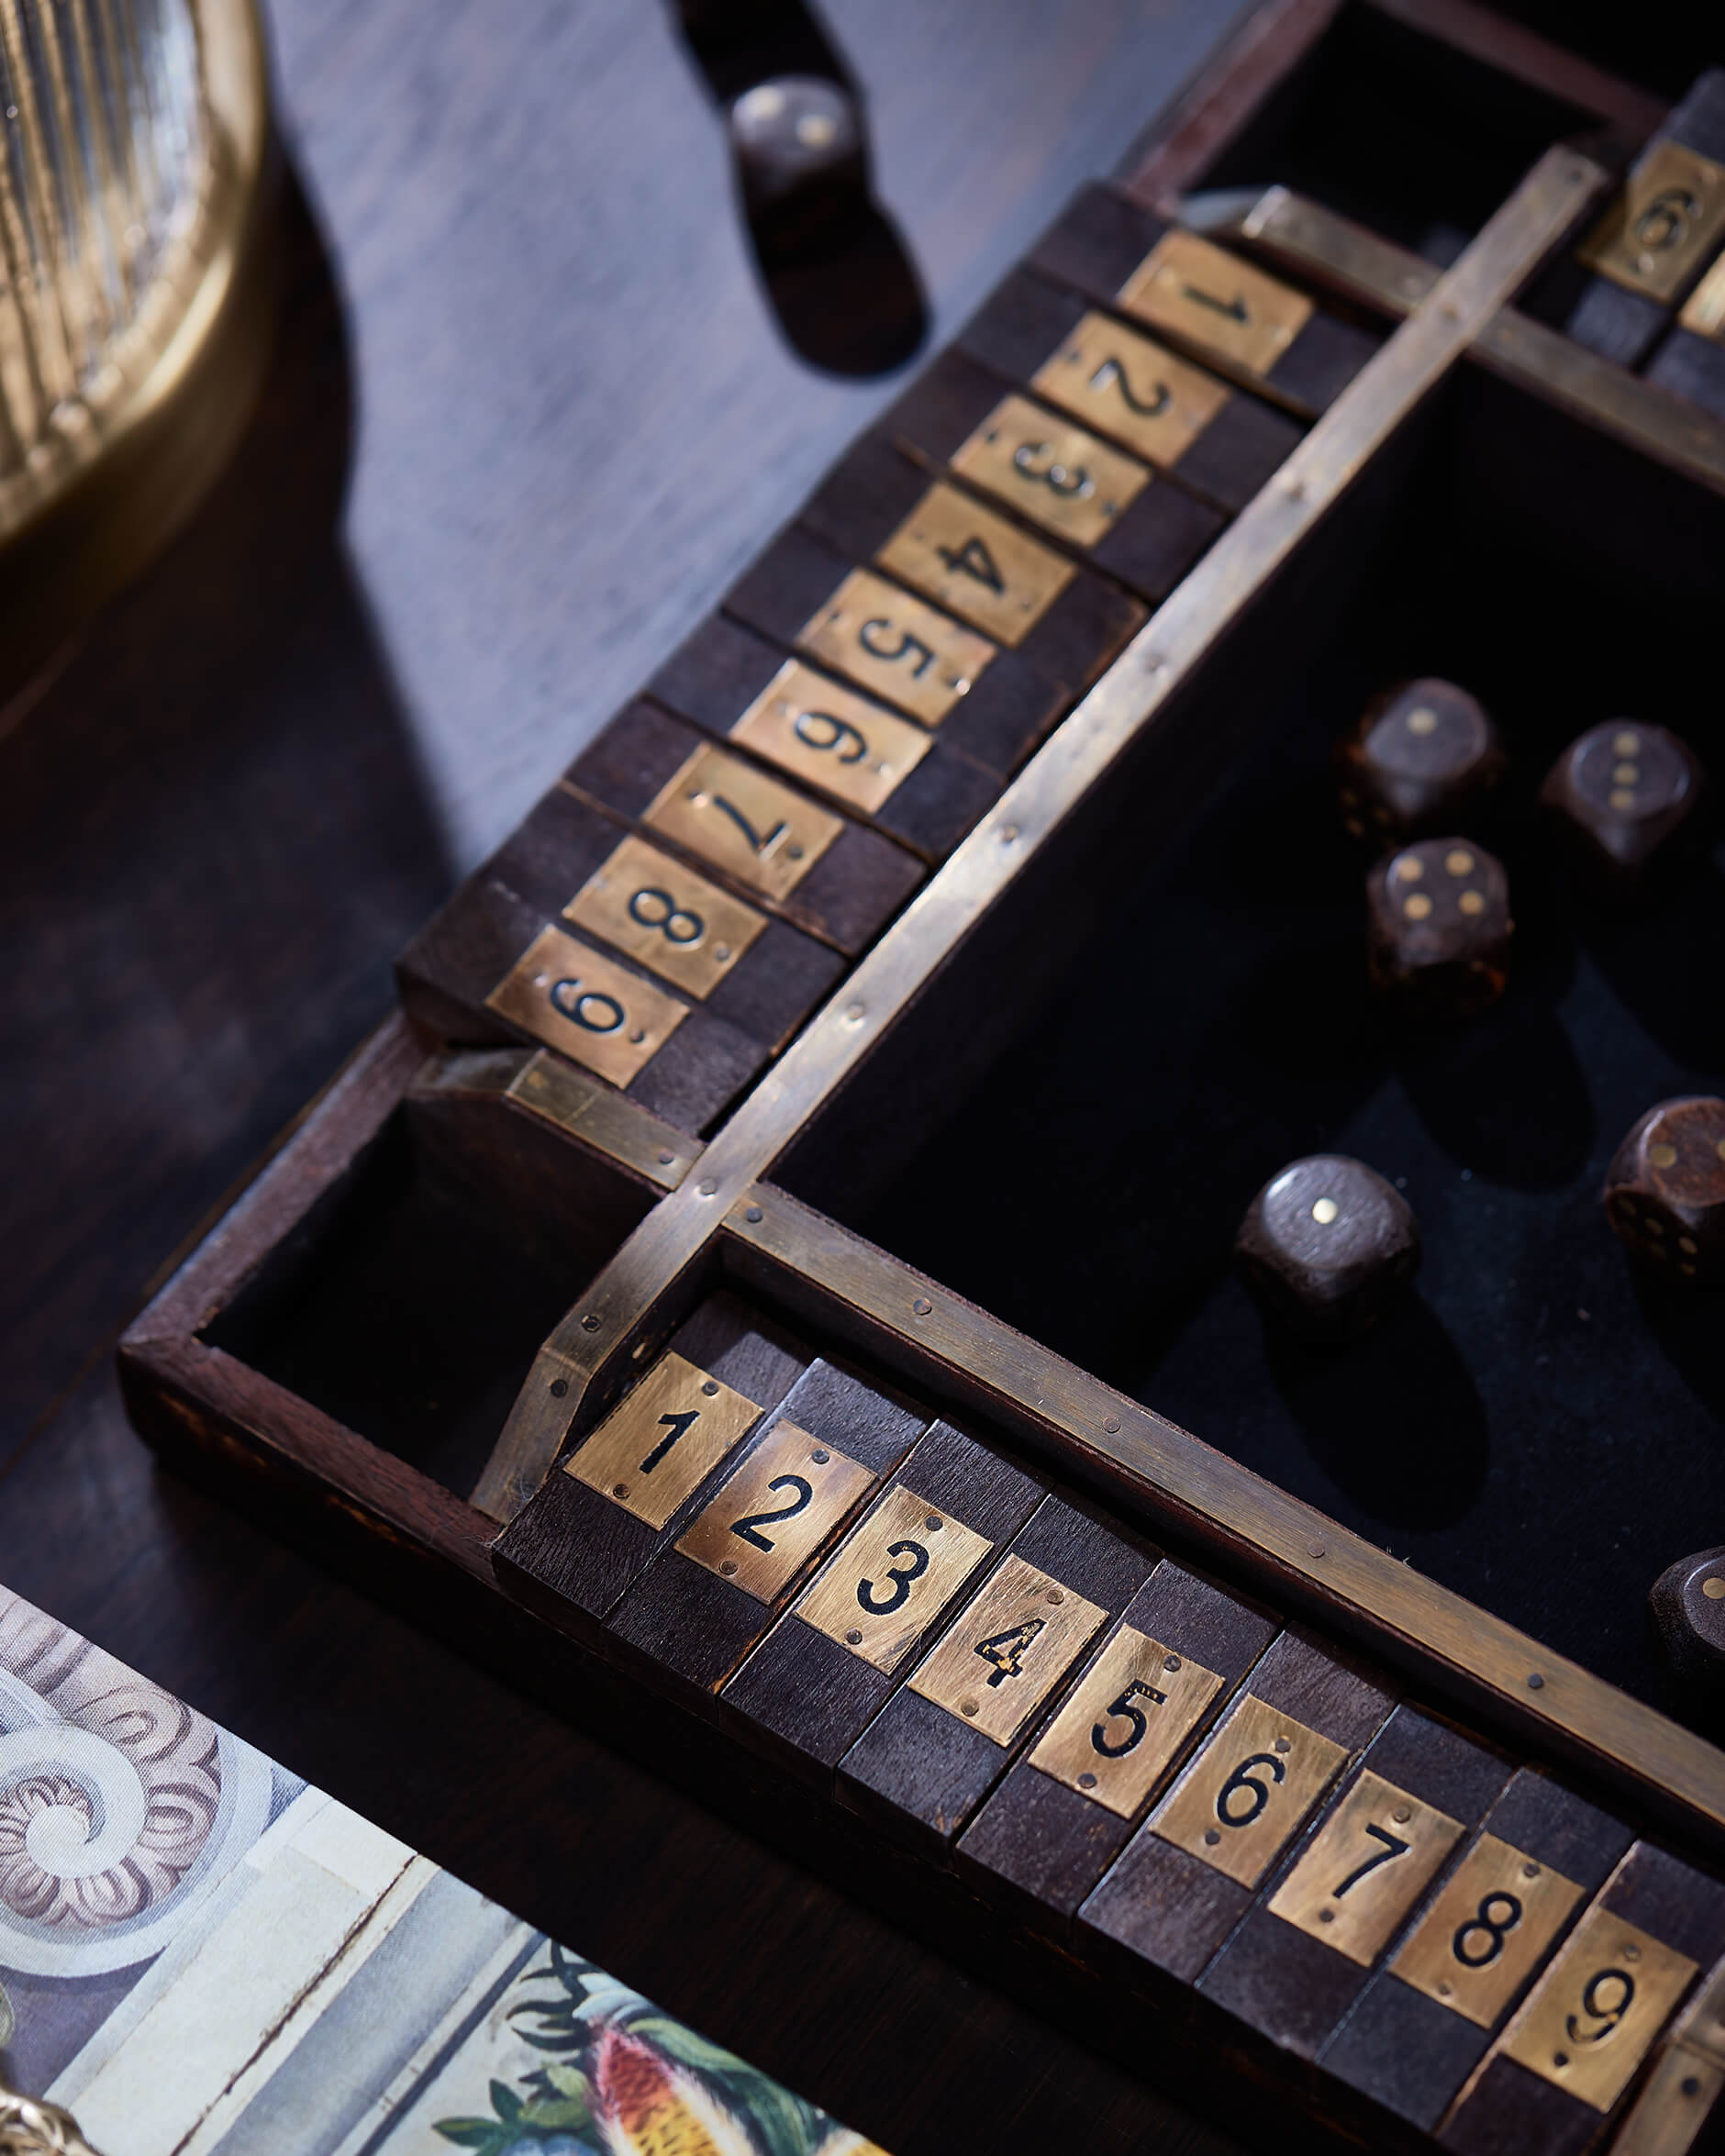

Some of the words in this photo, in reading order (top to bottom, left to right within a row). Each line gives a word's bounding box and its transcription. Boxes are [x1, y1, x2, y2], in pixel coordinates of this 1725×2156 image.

[1182, 286, 1250, 324] 1
[1090, 358, 1173, 417] 2
[1014, 442, 1094, 498] 3
[936, 539, 1005, 595] 4
[859, 618, 937, 678] 5
[793, 711, 867, 764] 6
[713, 795, 792, 861] 7
[629, 888, 705, 945] 8
[549, 979, 625, 1035] 9
[639, 1410, 701, 1474] 1
[729, 1474, 813, 1552] 2
[857, 1540, 929, 1616] 3
[974, 1618, 1048, 1688] 4
[1091, 1679, 1166, 1758] 5
[1216, 1752, 1286, 1828] 6
[1332, 1823, 1411, 1898] 7
[1452, 1892, 1522, 1968] 8
[1566, 1968, 1634, 2044] 9
